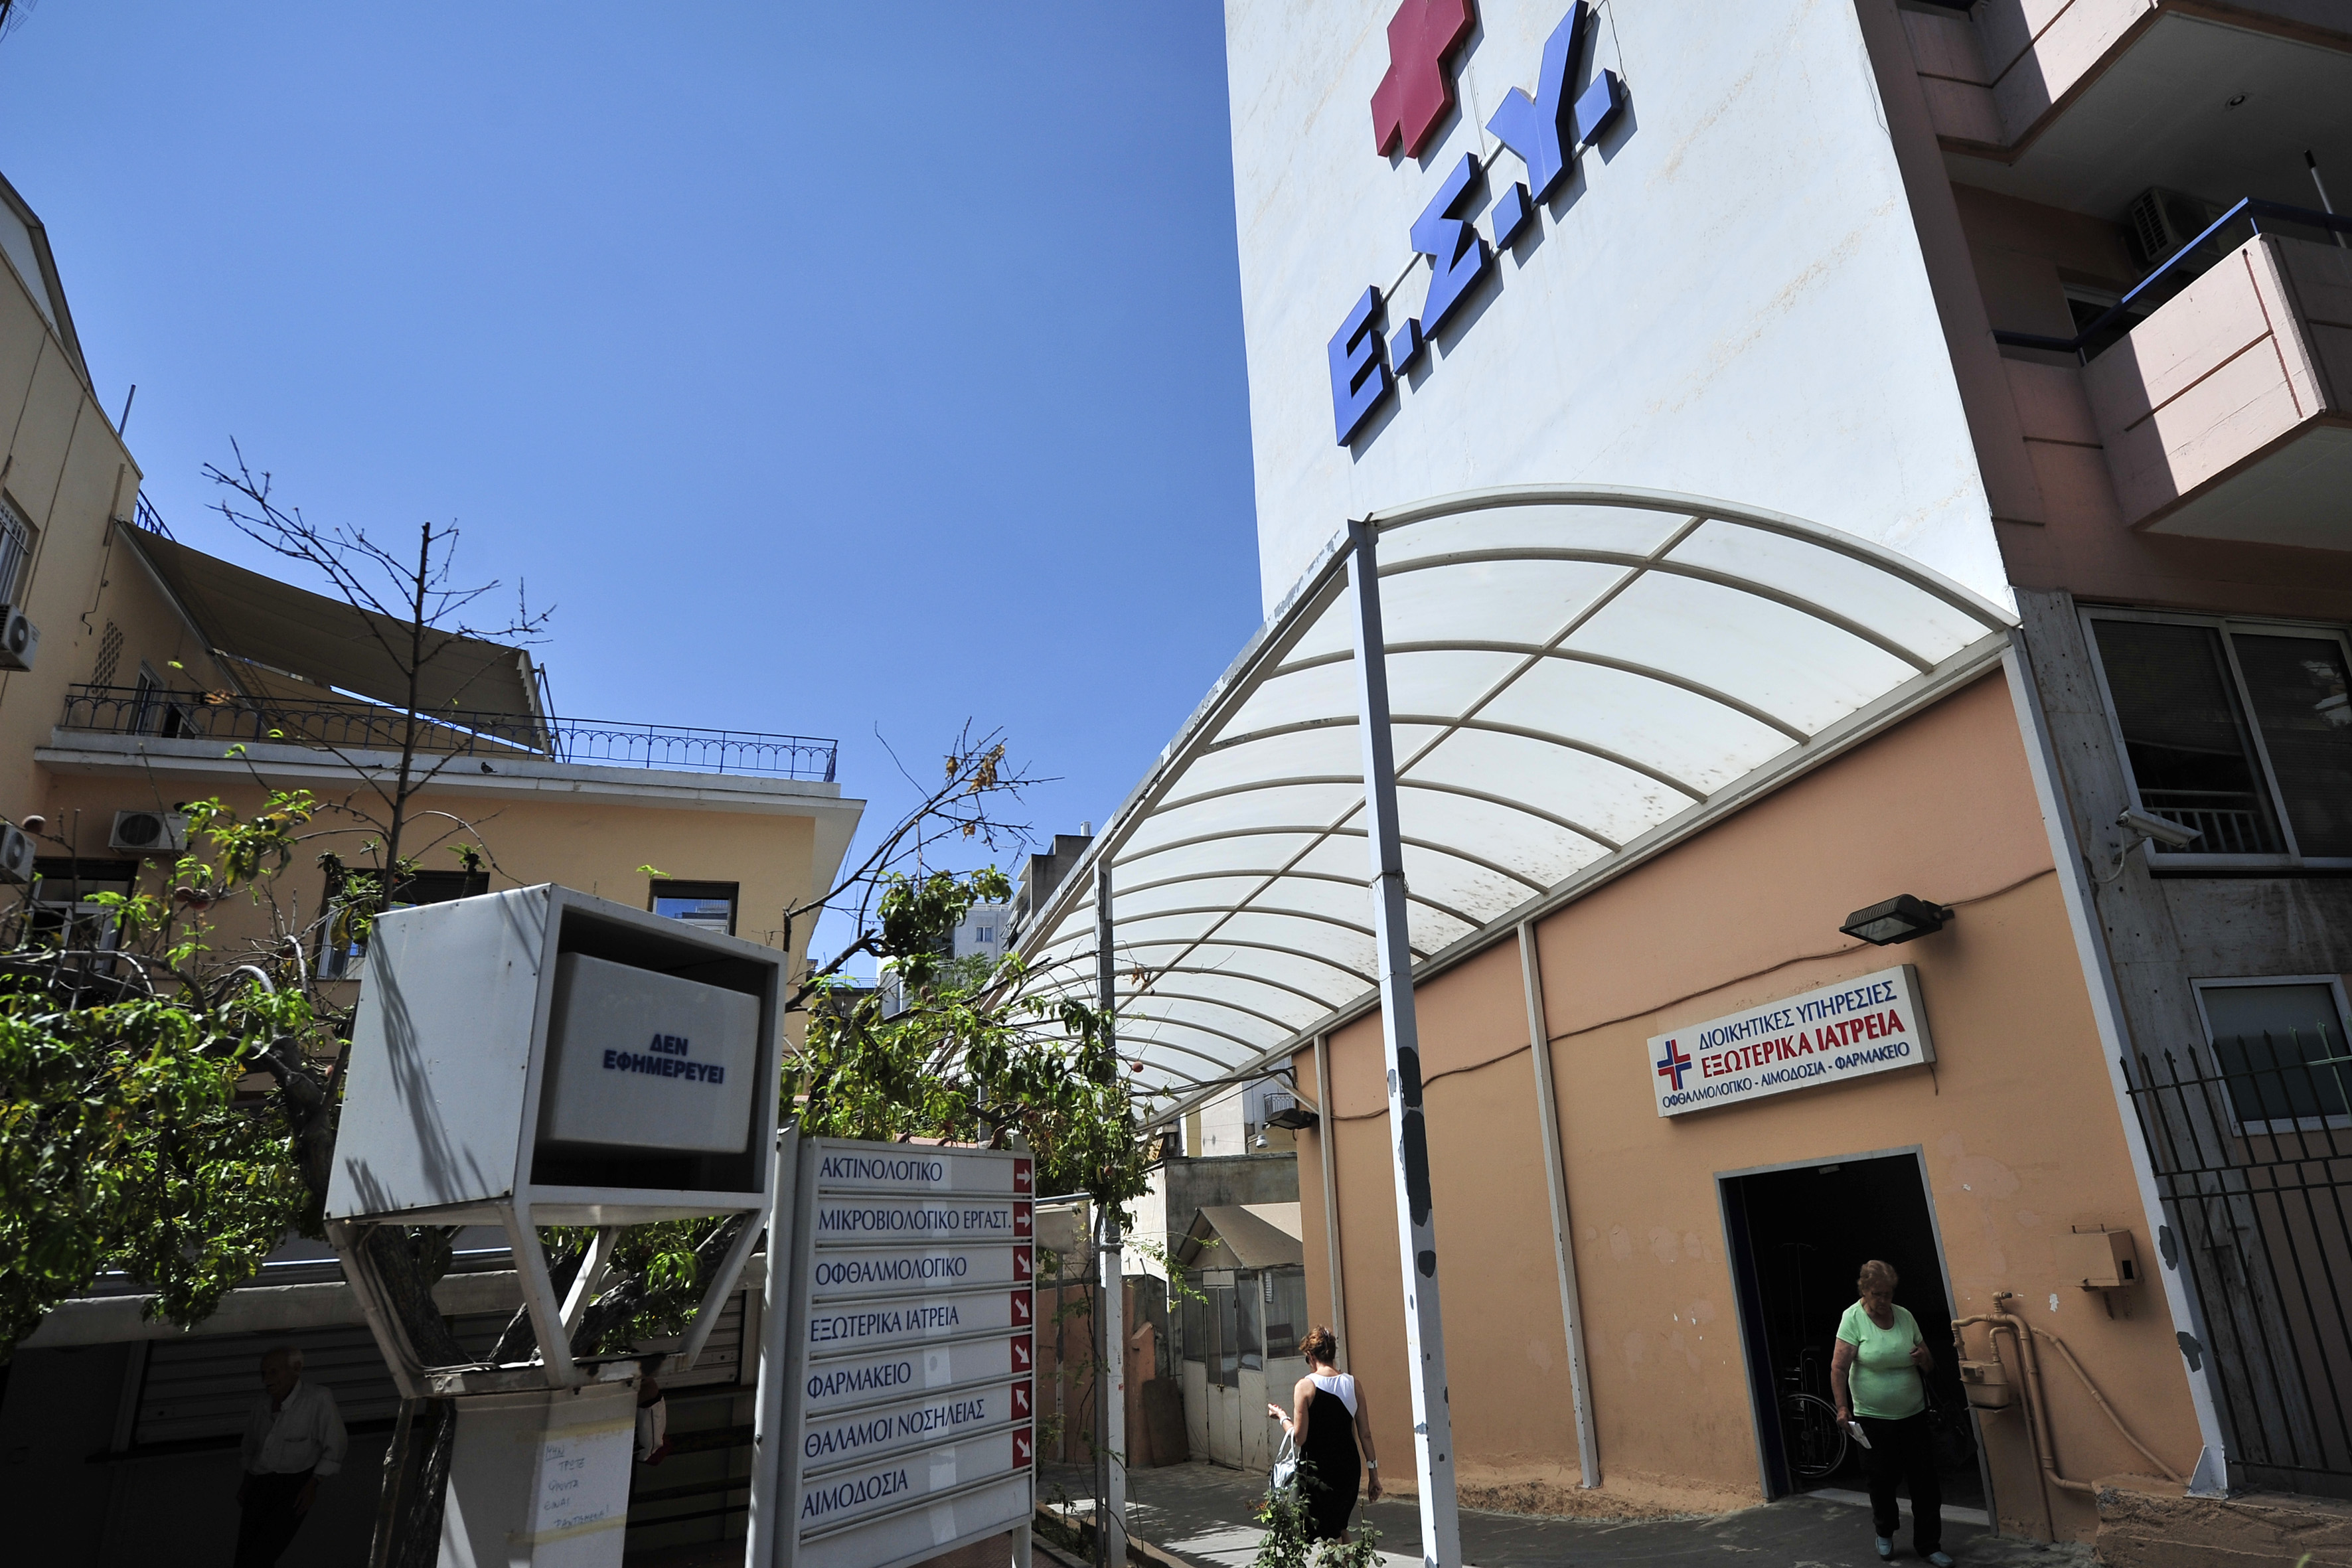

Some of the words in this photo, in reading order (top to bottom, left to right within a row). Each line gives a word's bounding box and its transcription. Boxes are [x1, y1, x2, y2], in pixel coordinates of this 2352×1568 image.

[1328, 0, 1624, 447] Ε.Σ.Υ.
[1699, 1008, 1794, 1050] ΔΙΟΙΚΗΤΙΚΕΣ
[1796, 980, 1897, 1023] ΥΠΗΡΕΣΙΕΣ
[649, 1034, 688, 1056] ΔΕΝ
[1700, 1032, 1814, 1078] ΕΞΩΤΕΡΙΚΑ
[1815, 1008, 1905, 1052] ΙΑΤΡΕΙΑ
[602, 1049, 724, 1084] ΕΦΗΜΕΡΕΥΕΙ
[1662, 1077, 1753, 1108] ΟΦΘΑΛΜΟΛΟΓΙΚΟ
[1761, 1061, 1826, 1087] ΑΙΜΟΔΟΣΙΑ
[1834, 1041, 1910, 1070] ΦΑΡΜΑΚΕΙΟ
[819, 1156, 943, 1182] ΑΚΤΙΝΟΛΟΓΙΚΟ
[818, 1209, 959, 1231] ΜΙΚΡΟΒΙΟΛΟΓΙΚΟ
[963, 1210, 1012, 1229] ΕΡΓΑΣΤ.
[815, 1257, 967, 1286] ΟΦΘΑΛΜΟΛΟΓΙΚΟ
[810, 1310, 902, 1342] ΕΞΩΤΕΡΙΚΑ
[905, 1305, 959, 1332] ΙΑΤΡΕΙΑ
[807, 1362, 911, 1399] ΦΑΡΜΑΚΕΙΟ
[804, 1419, 893, 1458] ΘΑΛΑΜΟΙ
[897, 1398, 985, 1437] ΝΟΣΗΛΕΙΑΣ
[801, 1468, 908, 1520] ΑΙΜΟΔΟΣΙΑ
